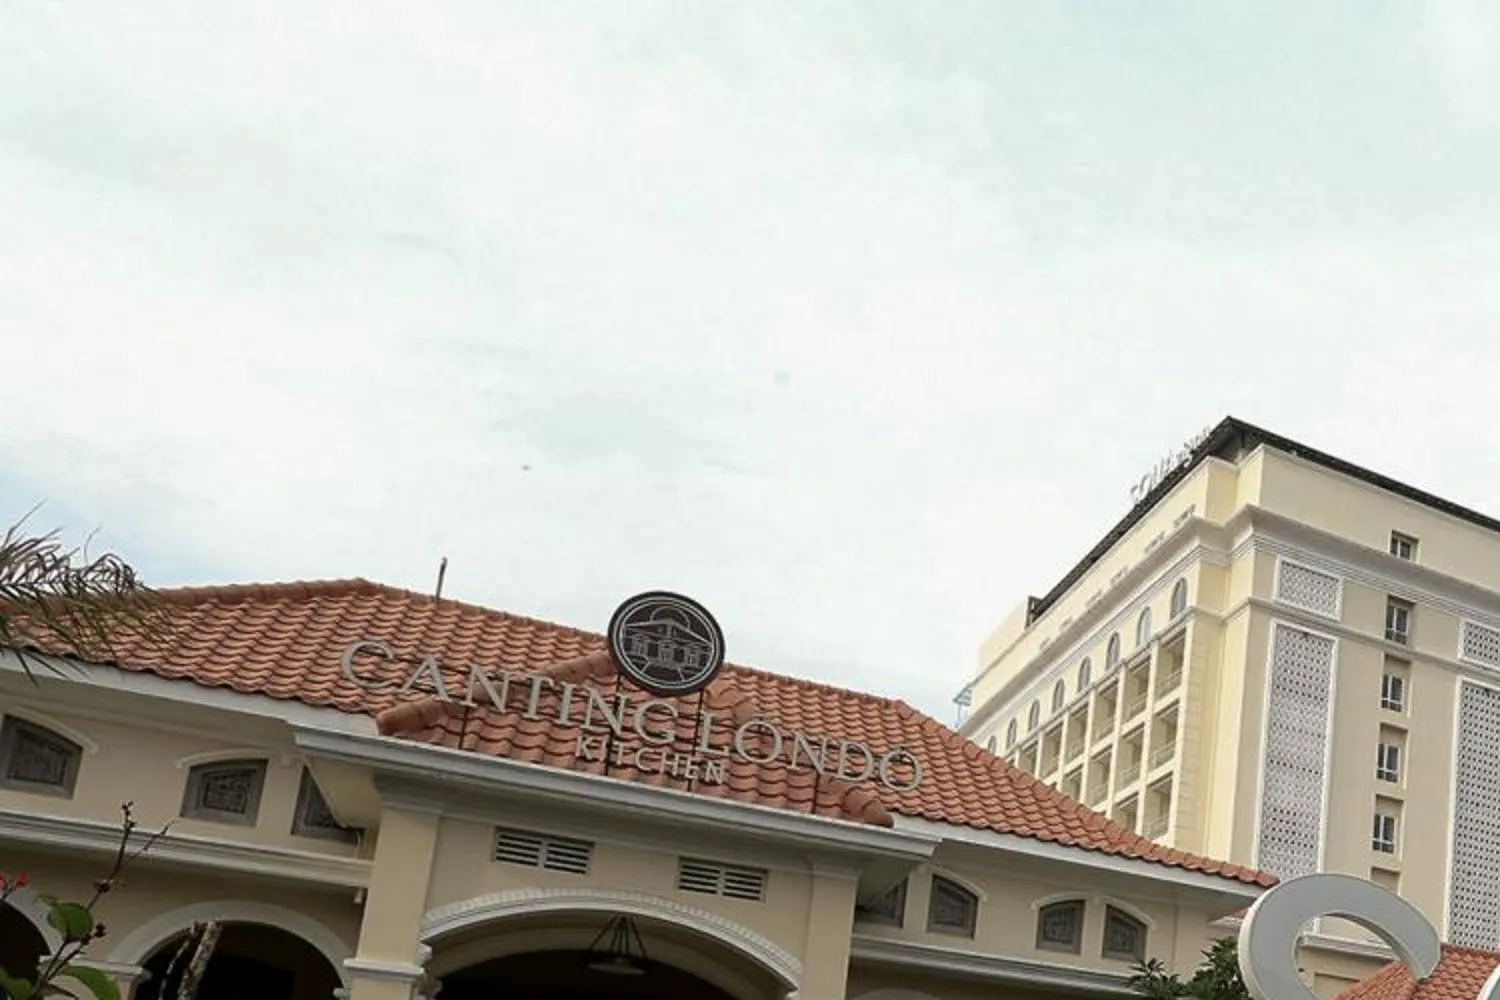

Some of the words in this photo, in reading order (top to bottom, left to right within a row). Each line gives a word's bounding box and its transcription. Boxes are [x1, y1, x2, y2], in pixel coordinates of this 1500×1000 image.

[340, 640, 679, 744] CANTING
[697, 709, 924, 792] LONDO
[575, 734, 726, 785] KITCHEN
